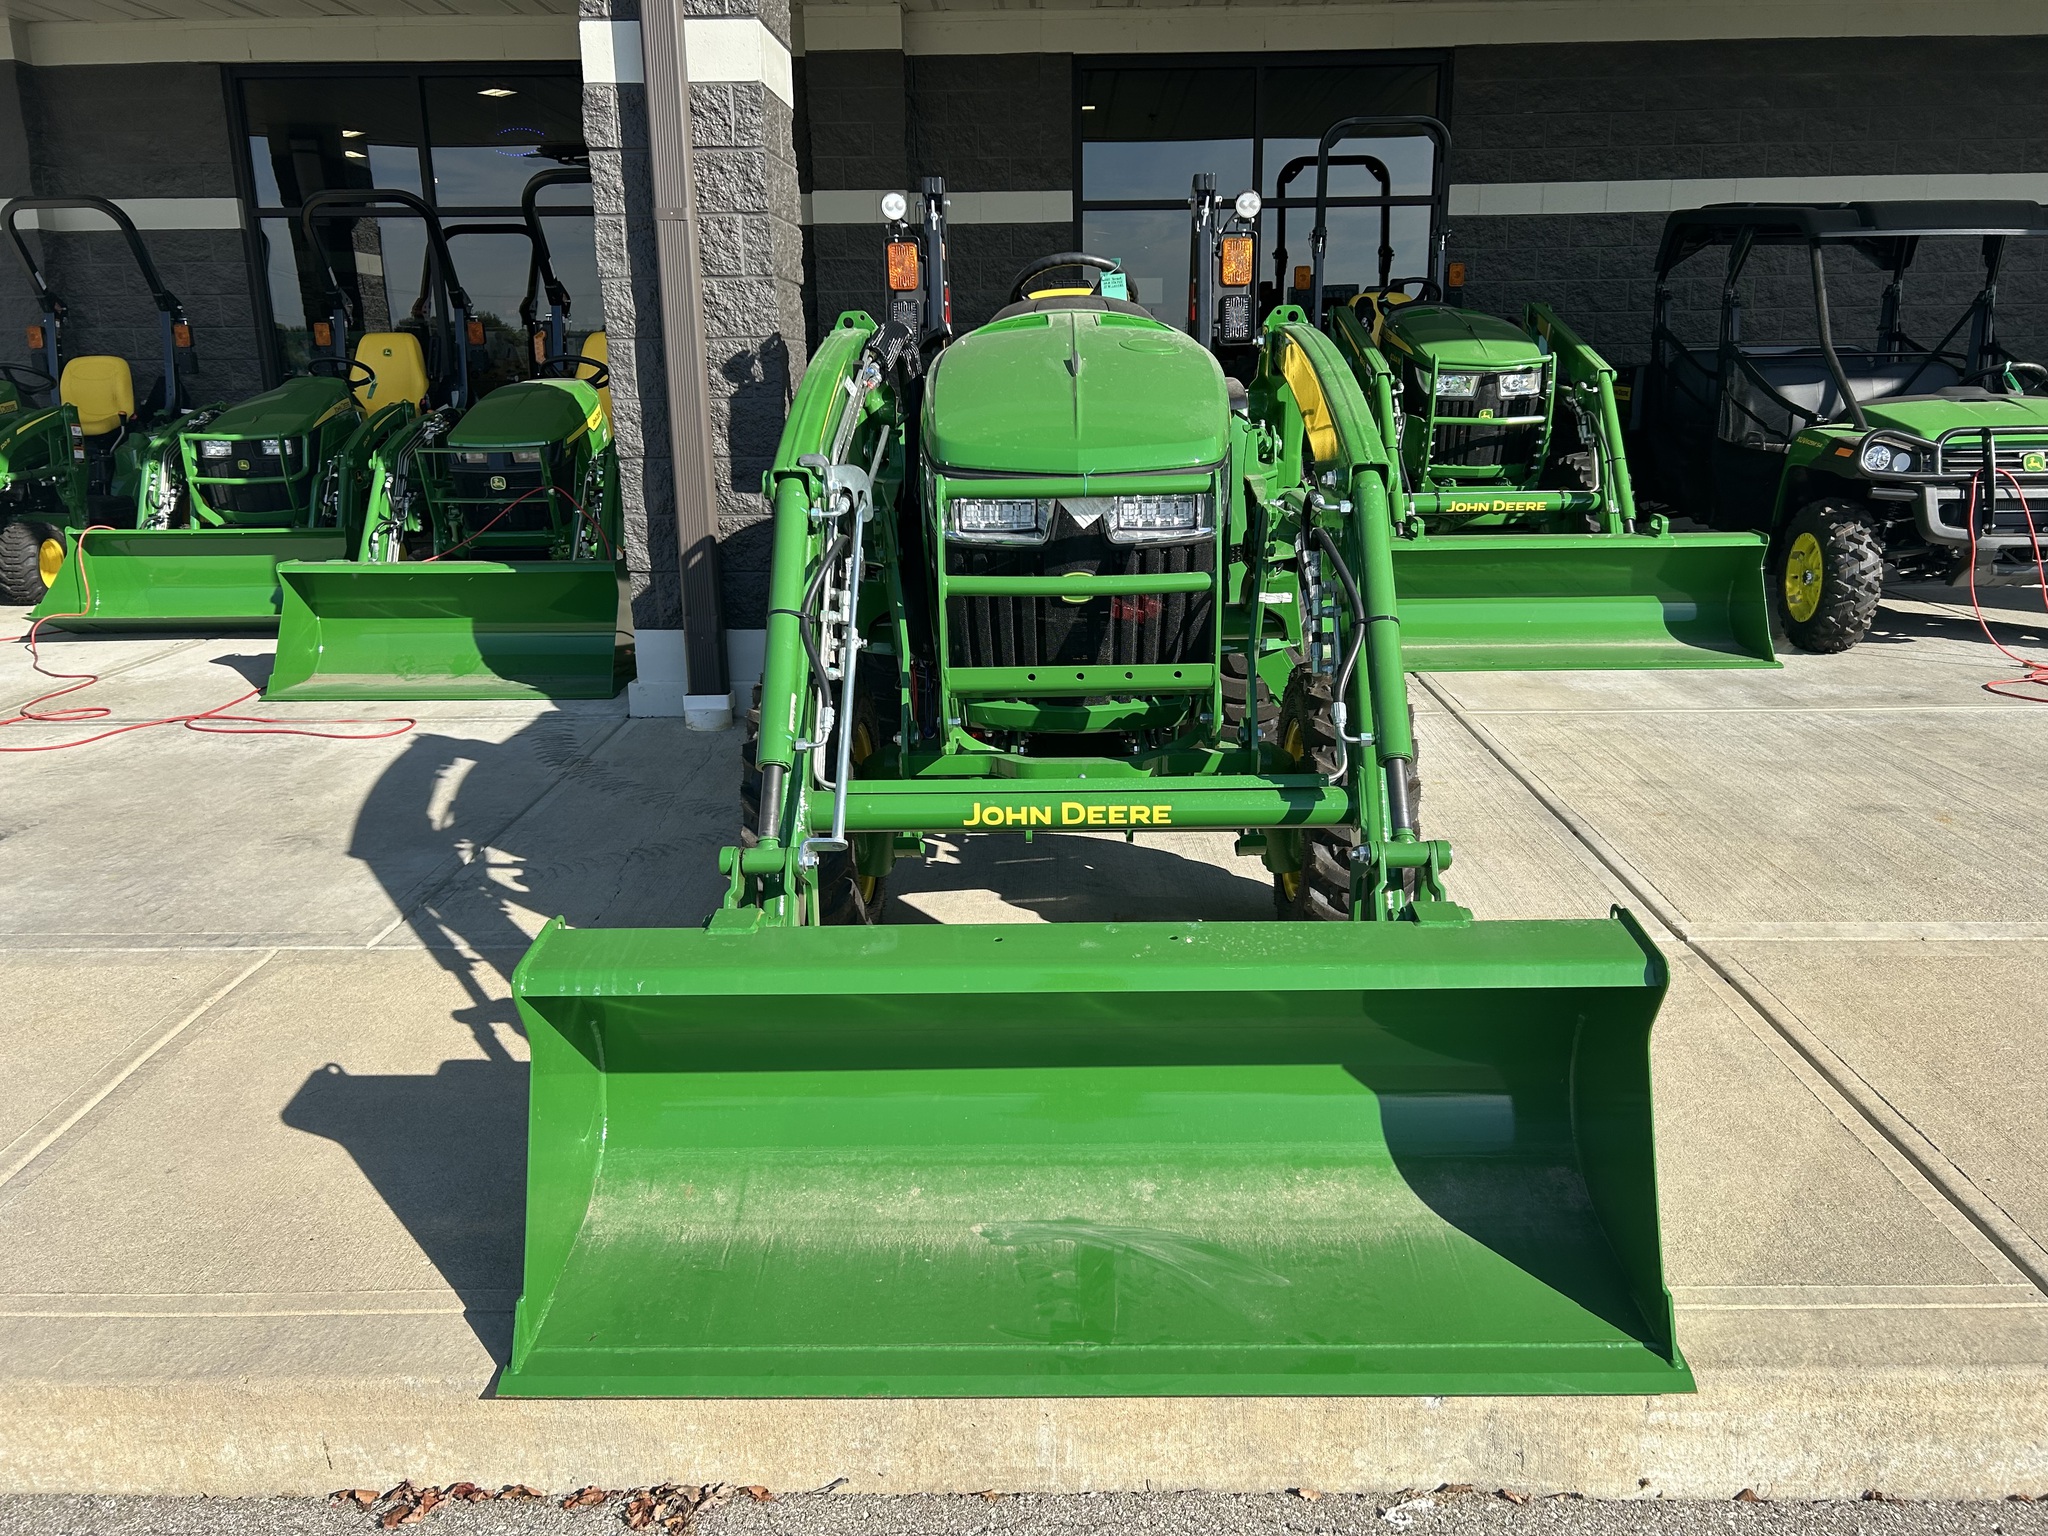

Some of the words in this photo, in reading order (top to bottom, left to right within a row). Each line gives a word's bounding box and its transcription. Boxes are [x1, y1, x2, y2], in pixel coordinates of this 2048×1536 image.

[1446, 501, 1490, 512] JOHN
[1493, 500, 1547, 511] DEERE
[963, 802, 1052, 826] JOHN
[1061, 801, 1172, 825] DEERE
